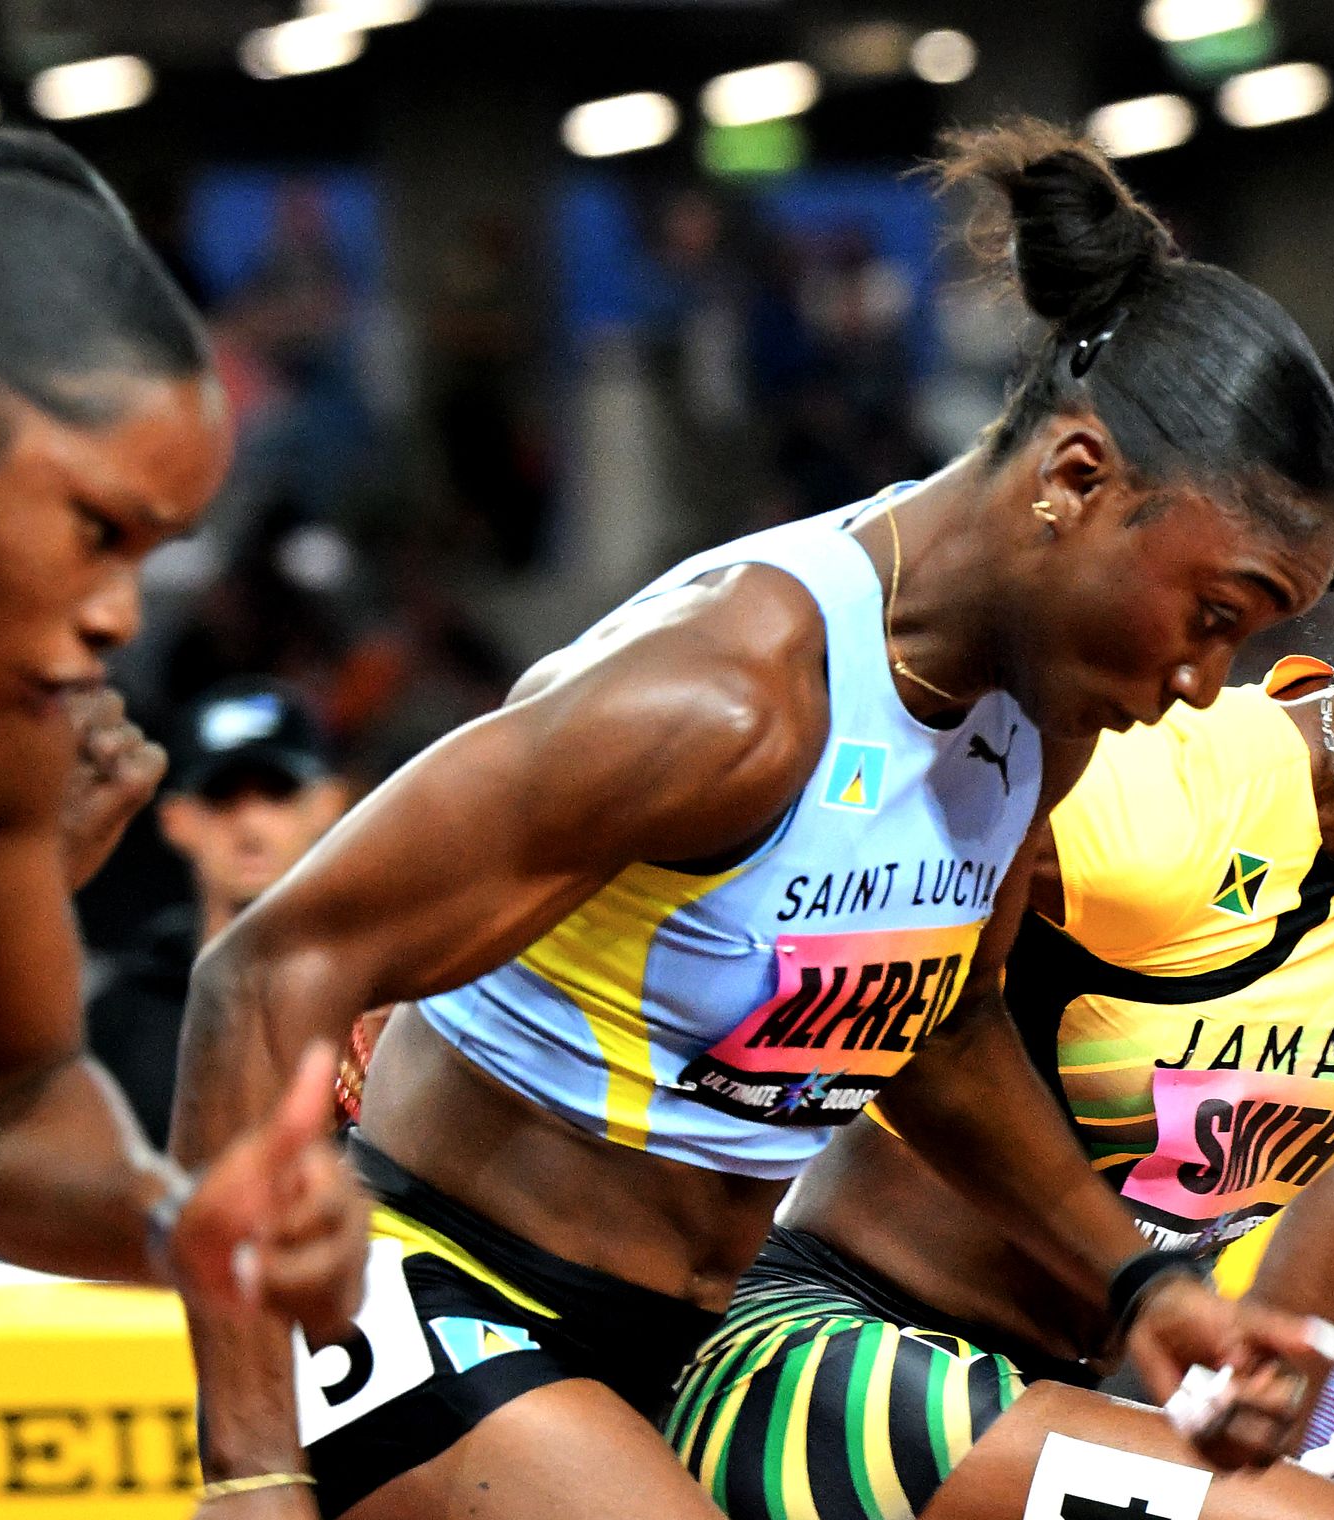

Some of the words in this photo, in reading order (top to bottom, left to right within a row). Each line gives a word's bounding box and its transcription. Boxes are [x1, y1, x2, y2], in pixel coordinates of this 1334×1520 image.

[777, 861, 899, 922] SAINT
[911, 858, 997, 909] LUCIA
[744, 952, 963, 1054] ALFRED
